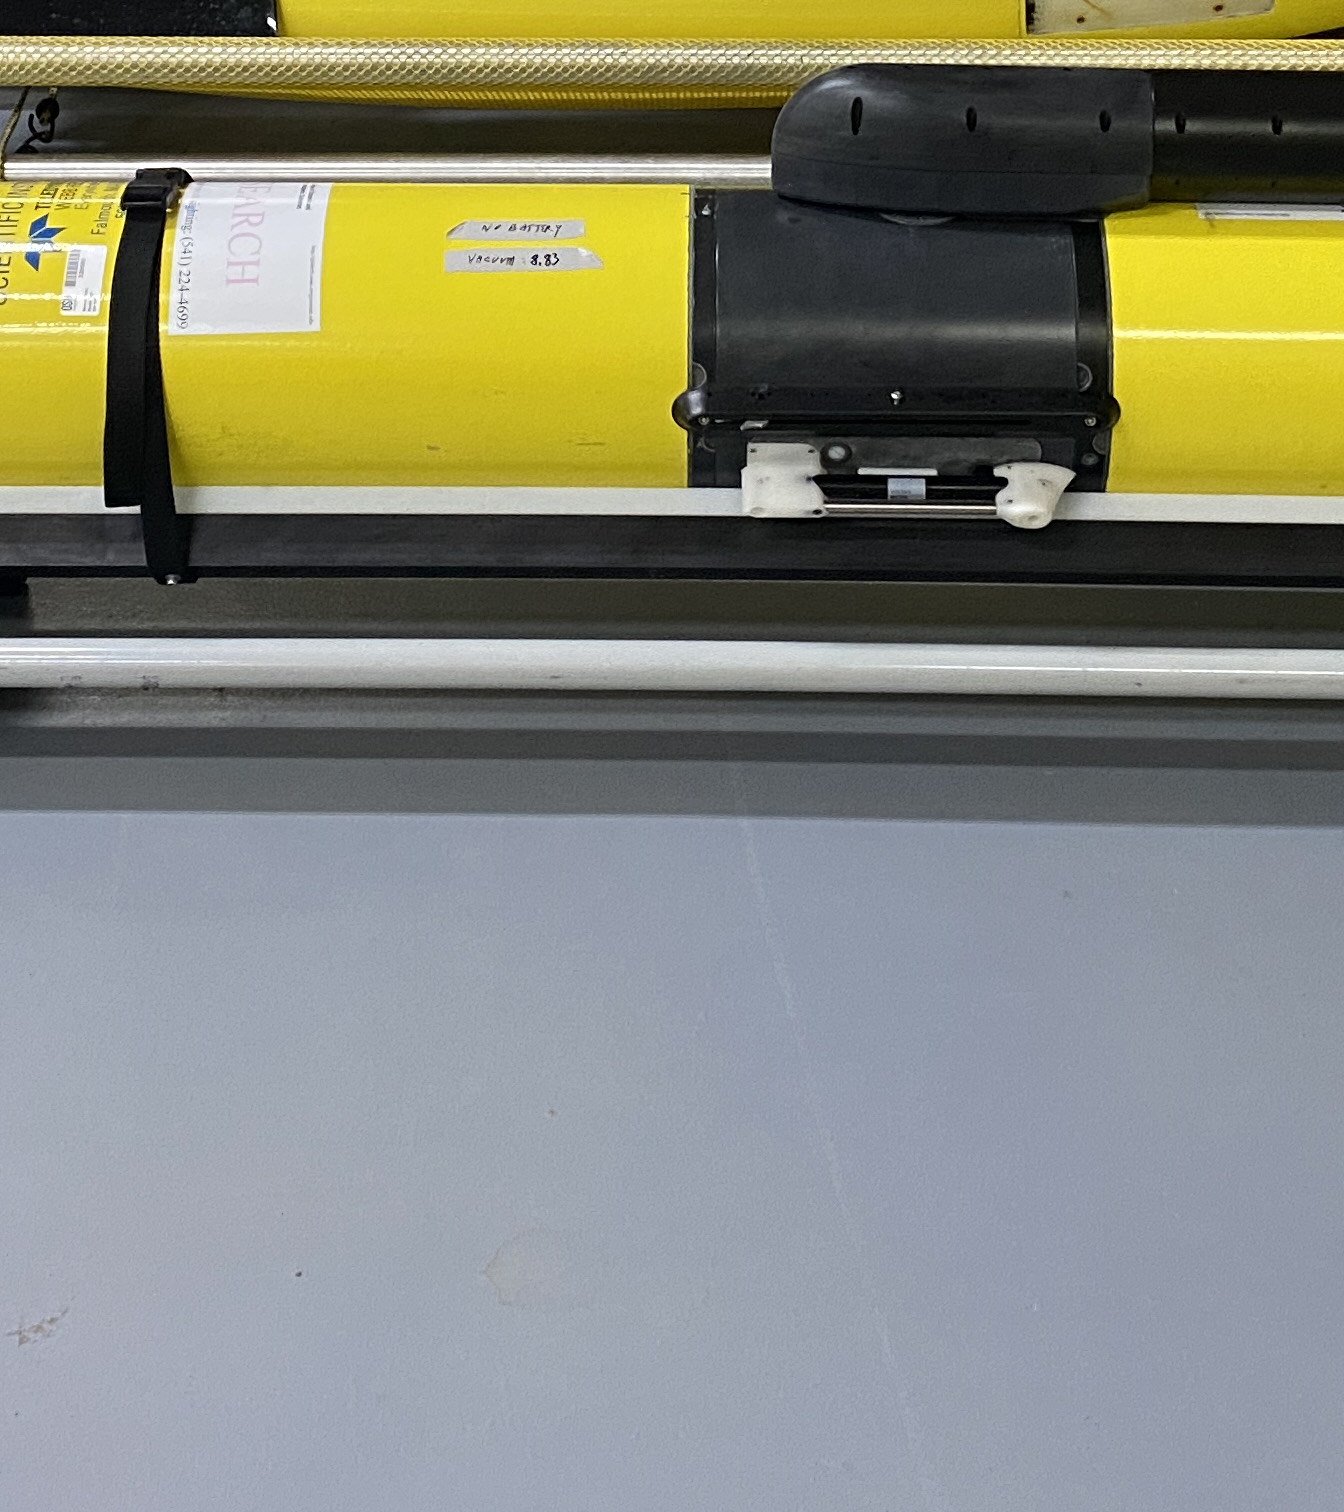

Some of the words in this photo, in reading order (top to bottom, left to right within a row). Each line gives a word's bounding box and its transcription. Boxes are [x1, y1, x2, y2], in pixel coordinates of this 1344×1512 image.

[507, 224, 563, 238] BATTERY
[177, 236, 194, 267] (541)
[530, 252, 560, 267] 8.83
[176, 268, 191, 330] 224-4699
